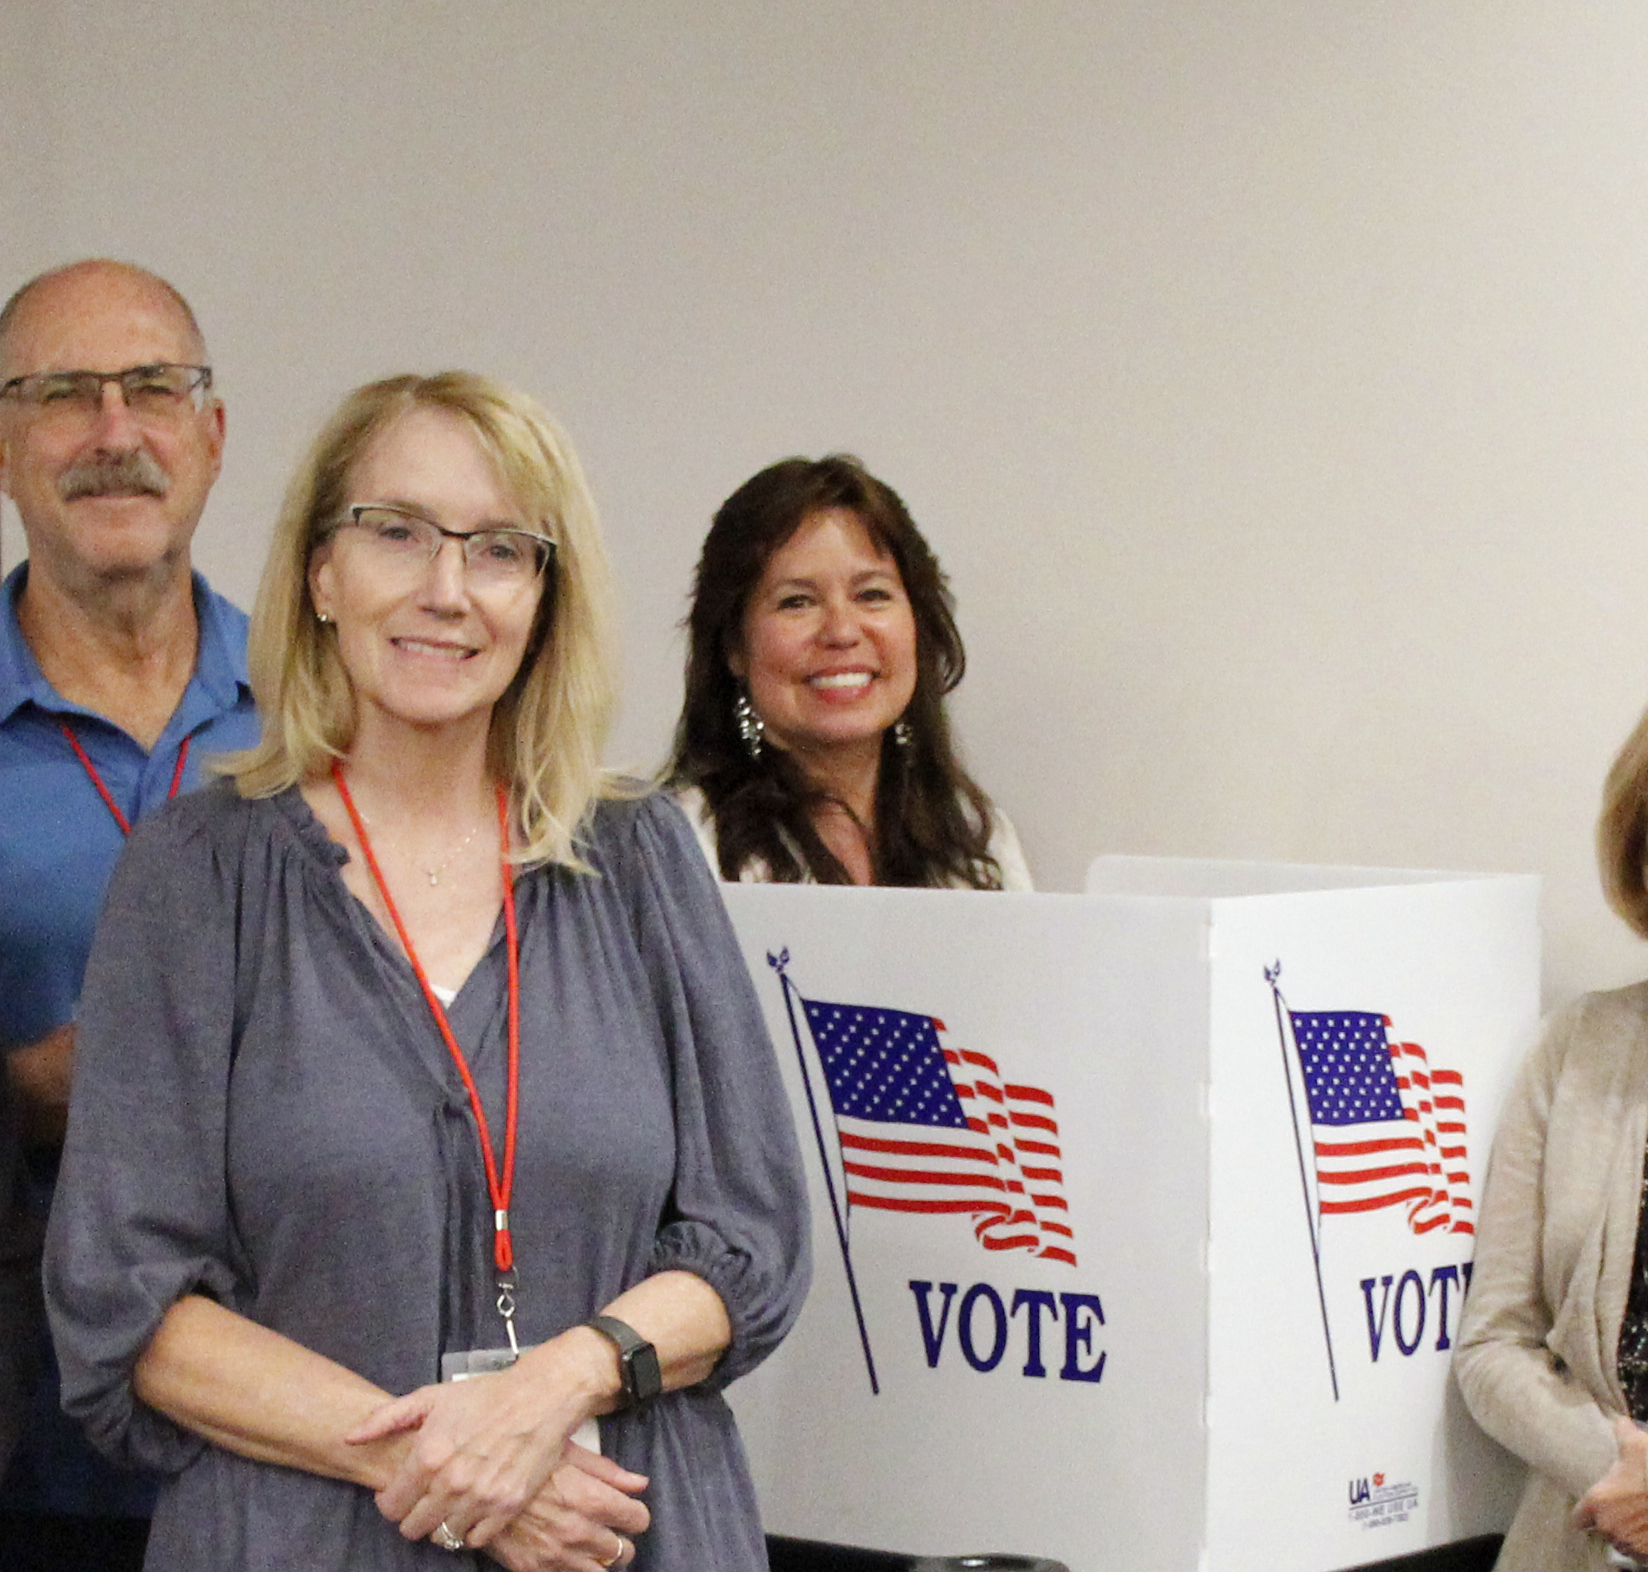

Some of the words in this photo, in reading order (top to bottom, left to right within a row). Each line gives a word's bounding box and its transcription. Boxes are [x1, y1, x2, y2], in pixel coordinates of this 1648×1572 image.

[908, 1279, 1106, 1382] VOTE
[1360, 1262, 1473, 1363] VOT
[1349, 1477, 1370, 1505] UA
